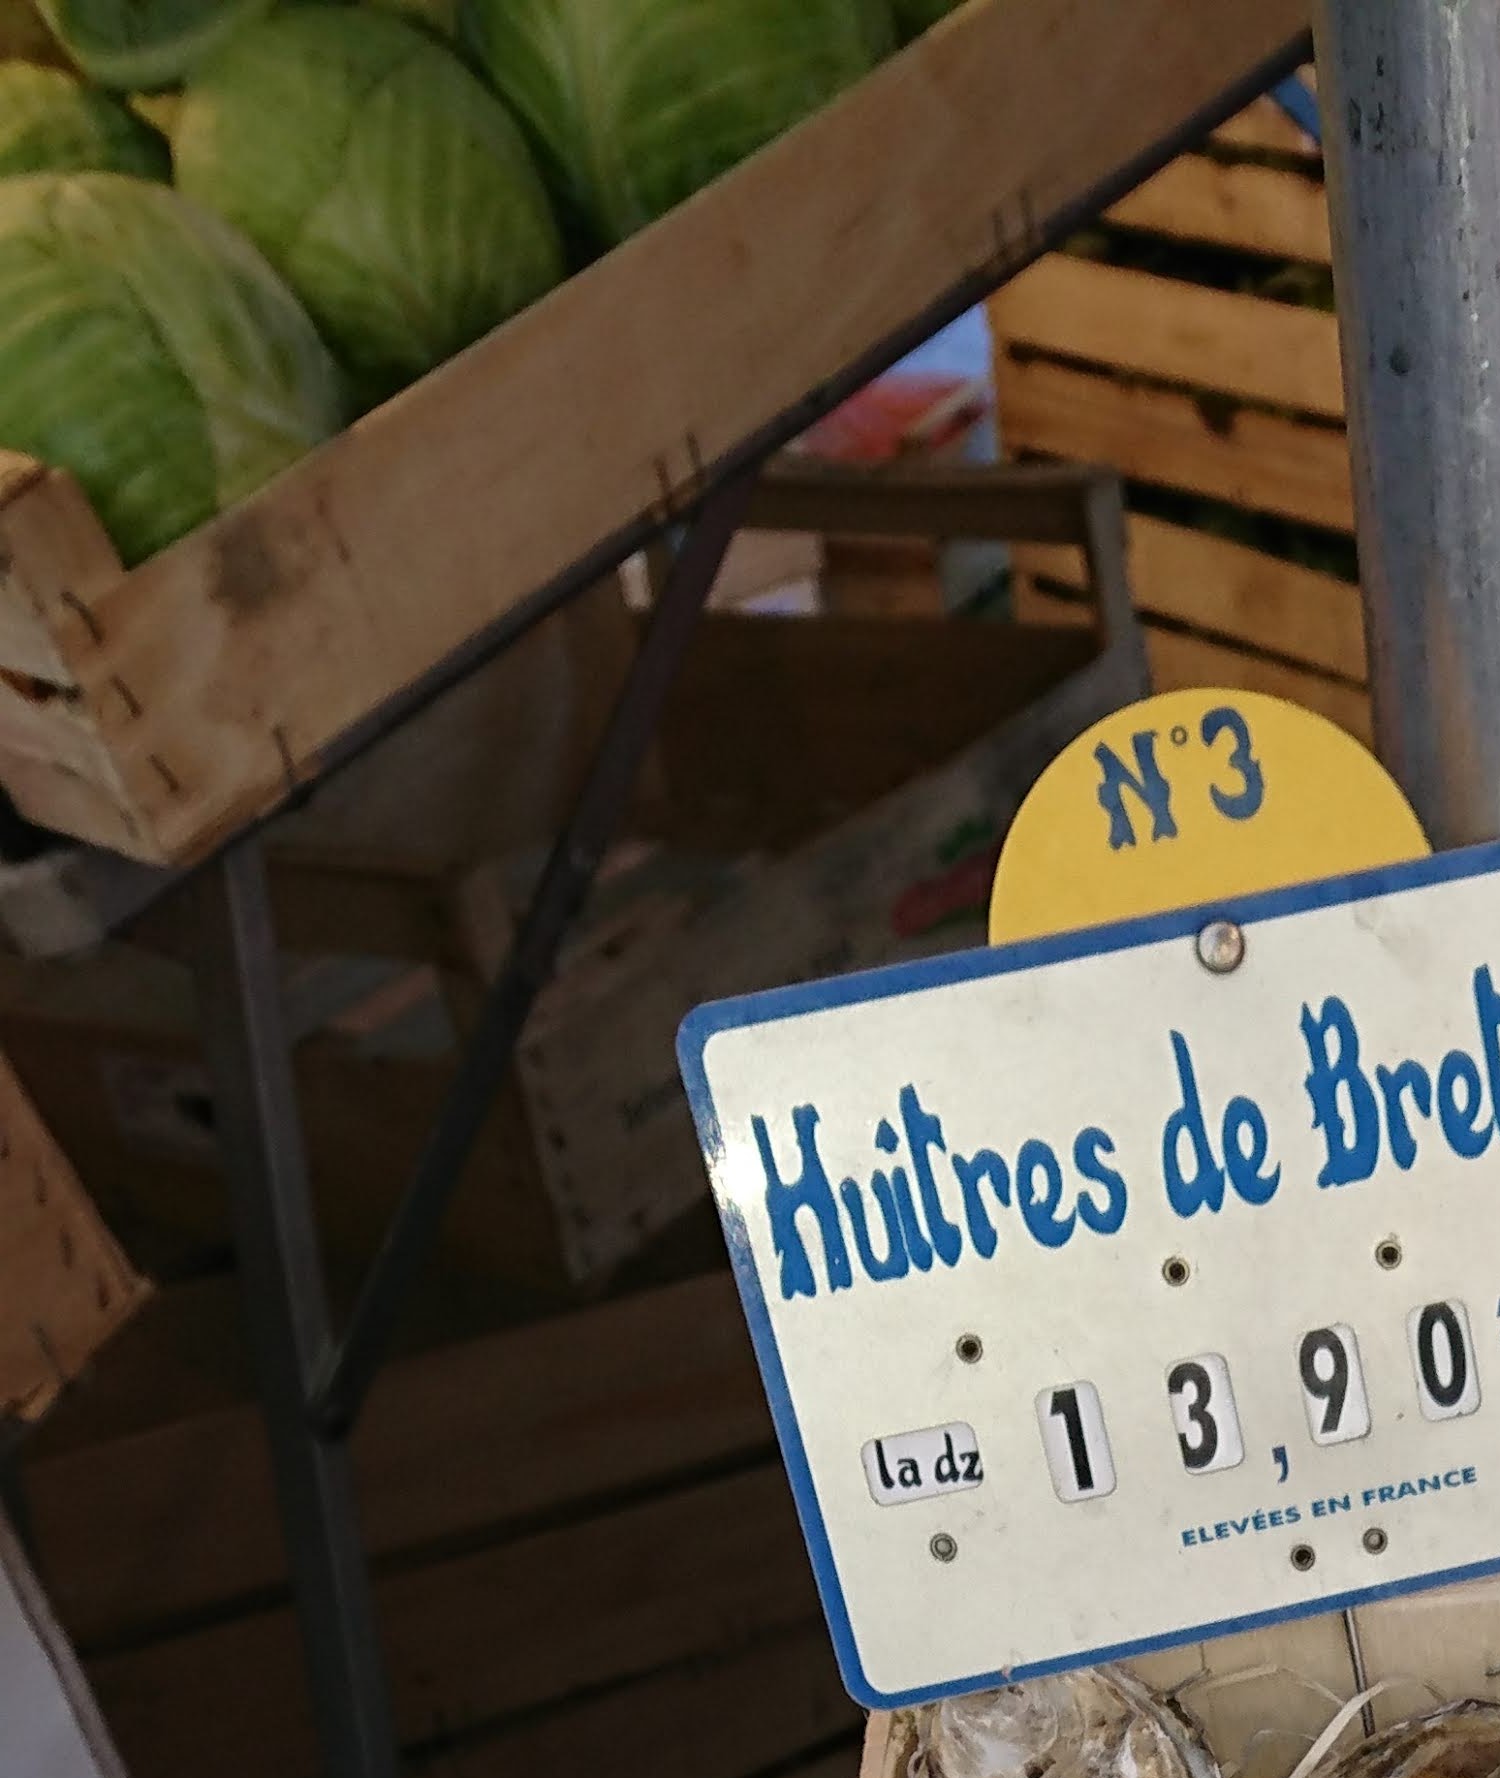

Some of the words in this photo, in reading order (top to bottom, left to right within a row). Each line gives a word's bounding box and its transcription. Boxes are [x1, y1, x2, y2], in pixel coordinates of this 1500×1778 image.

[753, 1085, 1128, 1300] Huîtres
[1162, 1031, 1282, 1219] de
[873, 1438, 922, 1490] la
[934, 1431, 984, 1484] dz
[1310, 1494, 1352, 1518] EN
[1361, 1465, 1478, 1506] FRANCE
